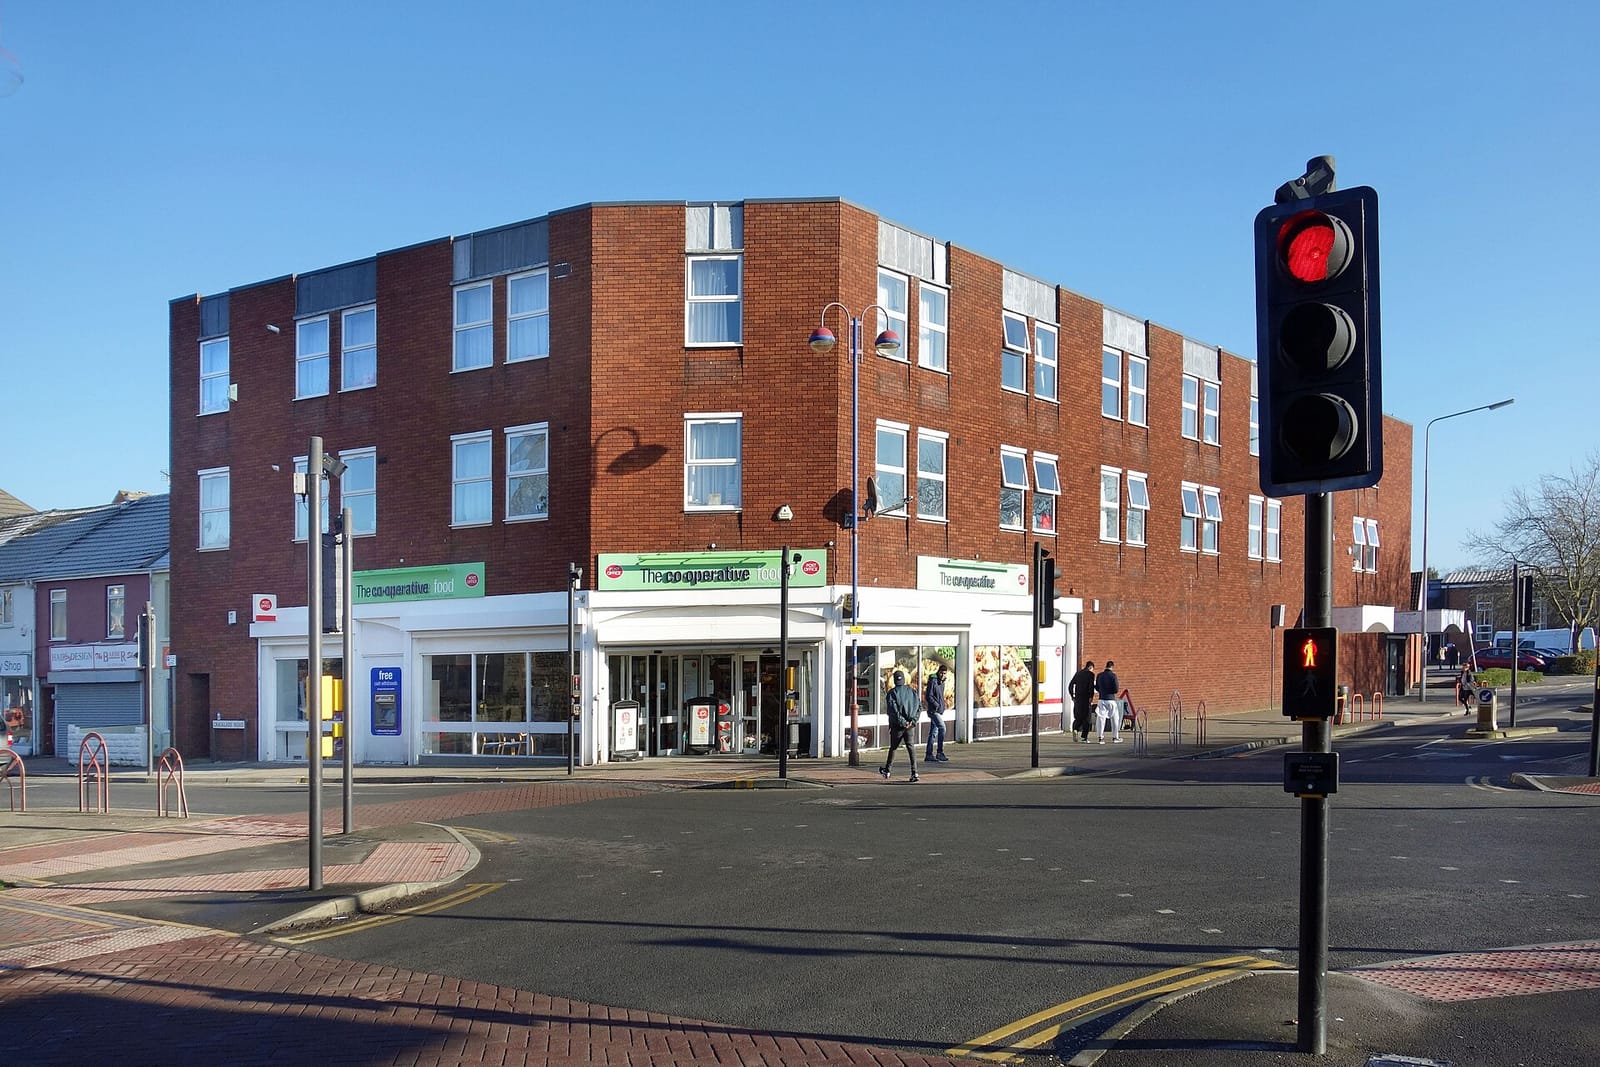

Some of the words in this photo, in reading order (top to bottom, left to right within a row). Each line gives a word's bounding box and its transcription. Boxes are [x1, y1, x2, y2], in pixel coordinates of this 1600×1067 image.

[640, 568, 662, 584] The
[940, 571, 952, 586] The
[356, 584, 371, 598] The
[434, 578, 455, 593] food
[4, 660, 22, 673] Shop
[378, 670, 393, 680] free
